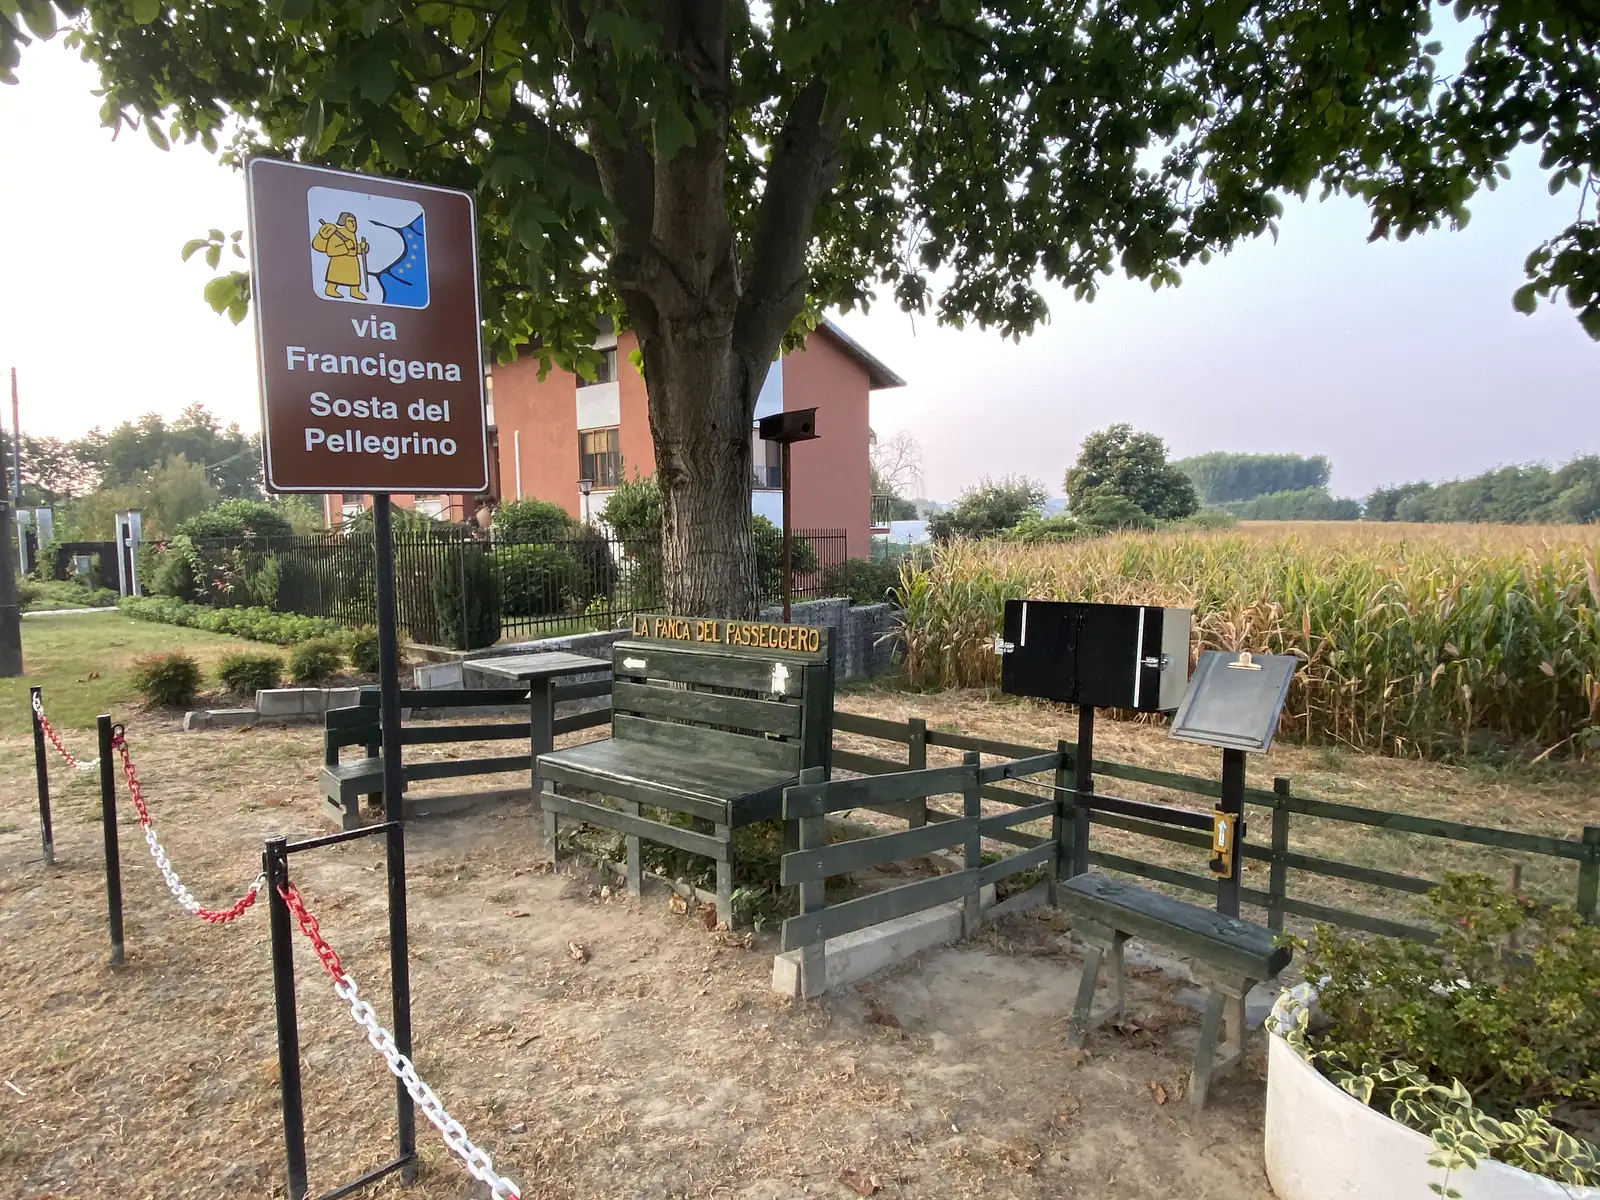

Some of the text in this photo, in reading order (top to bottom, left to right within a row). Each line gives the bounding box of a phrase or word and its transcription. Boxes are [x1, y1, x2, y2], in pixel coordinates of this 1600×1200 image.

[351, 315, 398, 341] via
[286, 346, 462, 384] Francigena
[310, 392, 451, 422] Sosta del
[304, 428, 458, 460] Pellegrino
[632, 616, 821, 652] LA PANCA DEL PASSEGGERO
